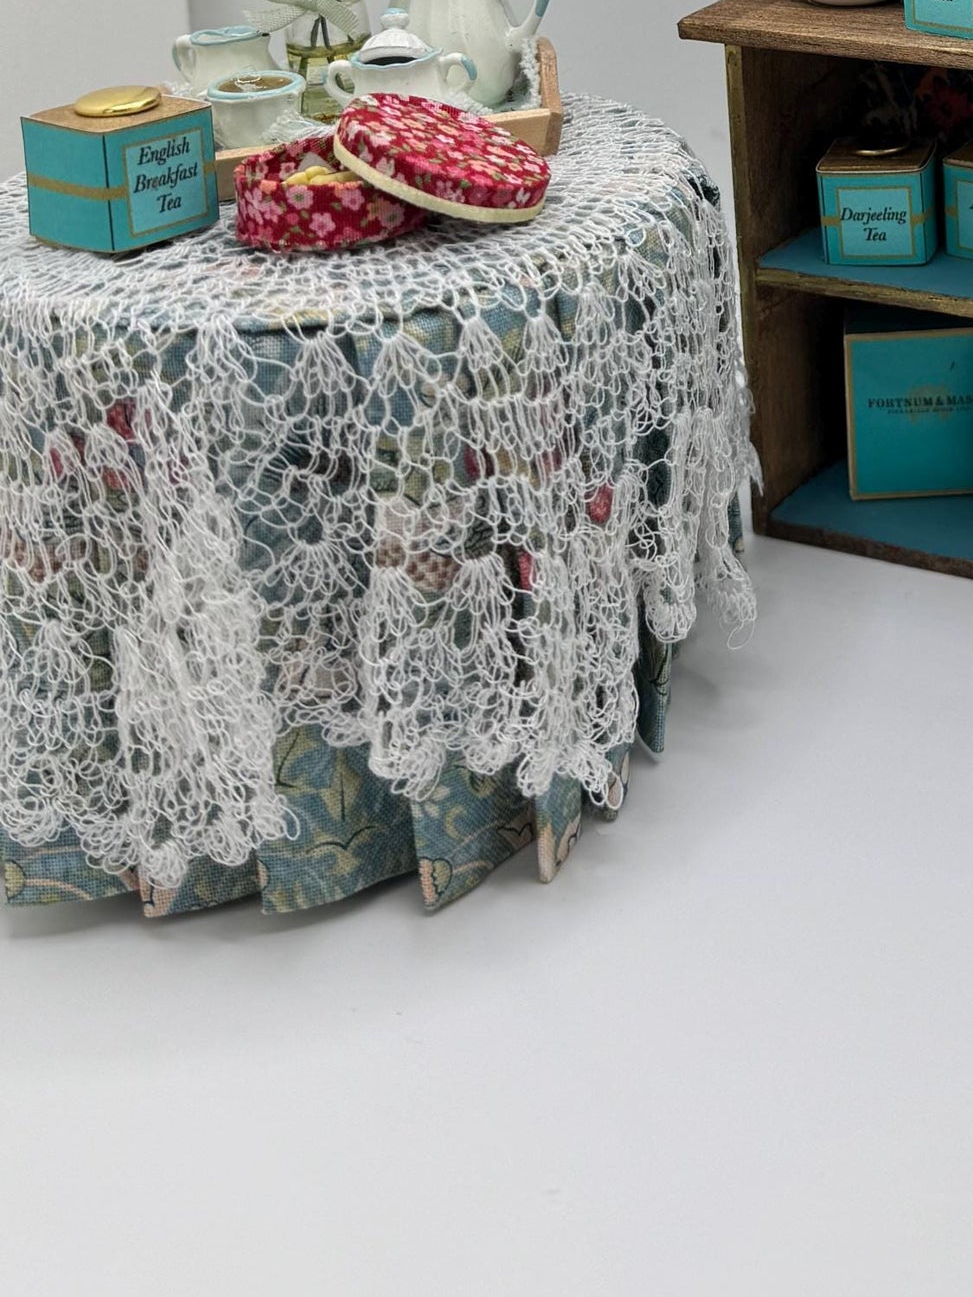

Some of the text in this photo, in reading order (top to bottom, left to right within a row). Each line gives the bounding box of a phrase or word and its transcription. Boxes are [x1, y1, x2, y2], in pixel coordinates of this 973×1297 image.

[137, 136, 190, 166] English
[133, 162, 199, 194] Breakfast
[157, 193, 182, 214] Tea
[839, 207, 908, 228] Darjeeling
[863, 226, 888, 243] Tea
